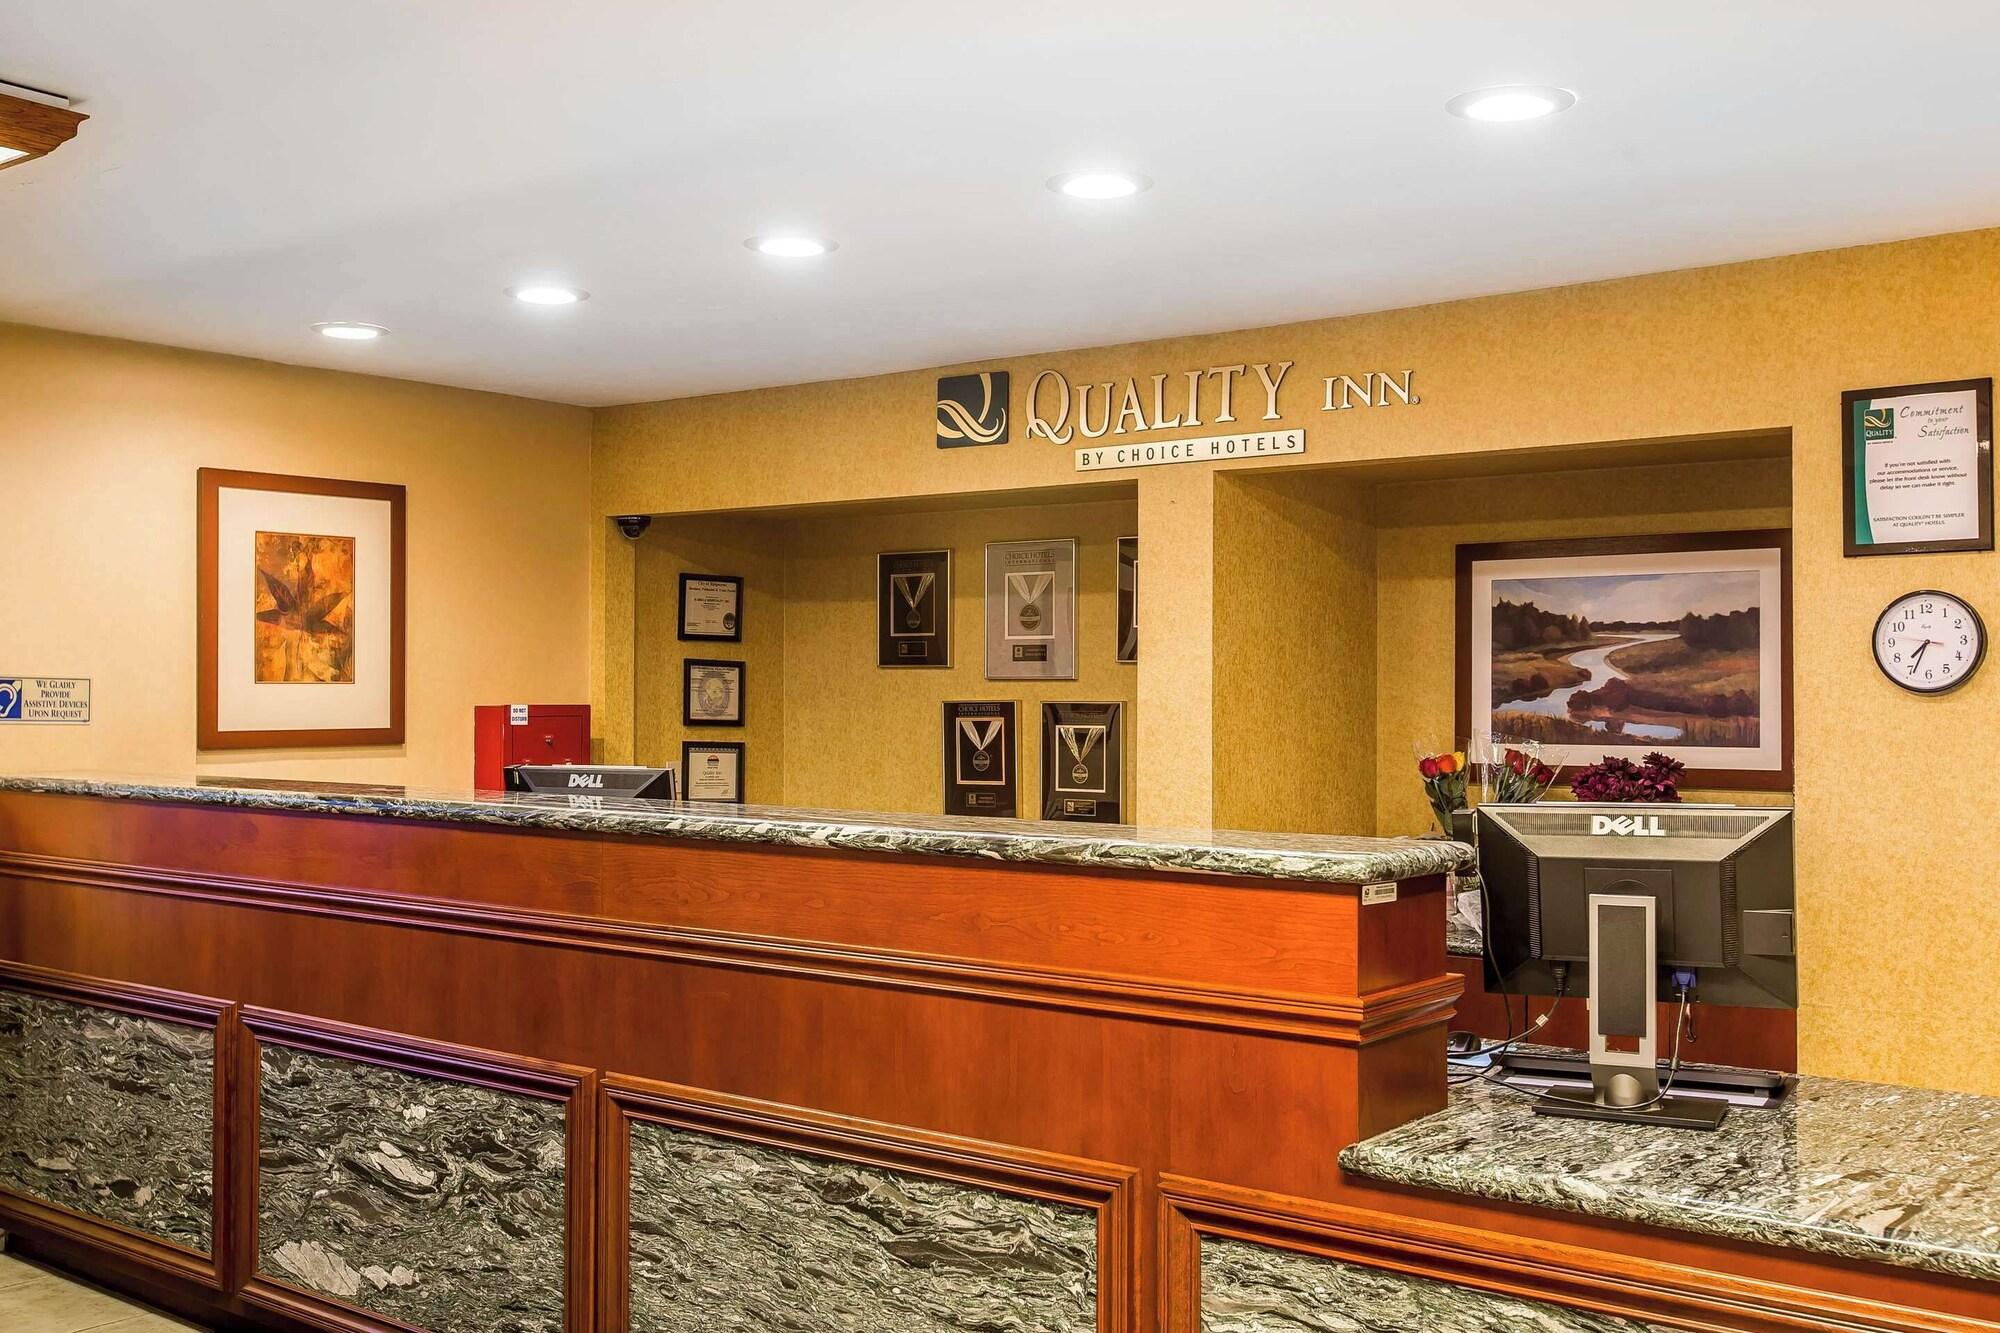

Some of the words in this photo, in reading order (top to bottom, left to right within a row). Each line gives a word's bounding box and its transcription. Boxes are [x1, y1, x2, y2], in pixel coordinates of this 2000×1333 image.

[1025, 361, 1294, 445] QUALITY
[1900, 404, 1964, 418] Commitment
[1866, 429, 1893, 437] QUALITY
[1918, 425, 1969, 440] Satisfaction
[1082, 451, 1104, 466] BY
[1117, 443, 1194, 463] CHOICE
[1211, 435, 1296, 455] HOTELS
[1920, 603, 1932, 614] 12
[1943, 608, 1948, 618] 1
[1905, 610, 1914, 619] 11
[1893, 622, 1905, 632] 10
[1954, 619, 1962, 629] 2
[1888, 638, 1895, 648] 9
[1960, 635, 1967, 645] 3
[1893, 653, 1901, 663] 8
[1955, 650, 1963, 661] 4
[1907, 665, 1914, 675] 7
[1943, 664, 1950, 674] 5
[1925, 670, 1932, 680] 6
[36, 680, 47, 688] WE
[49, 681, 76, 689] GLADLY
[41, 690, 70, 698] PROVIDE
[24, 700, 58, 708] ASSISTIVE
[60, 700, 88, 708] DEVICES
[29, 710, 49, 718] UPON
[51, 710, 82, 719] REQUEST
[568, 774, 604, 788] DELL
[1591, 815, 1667, 836] DELL
